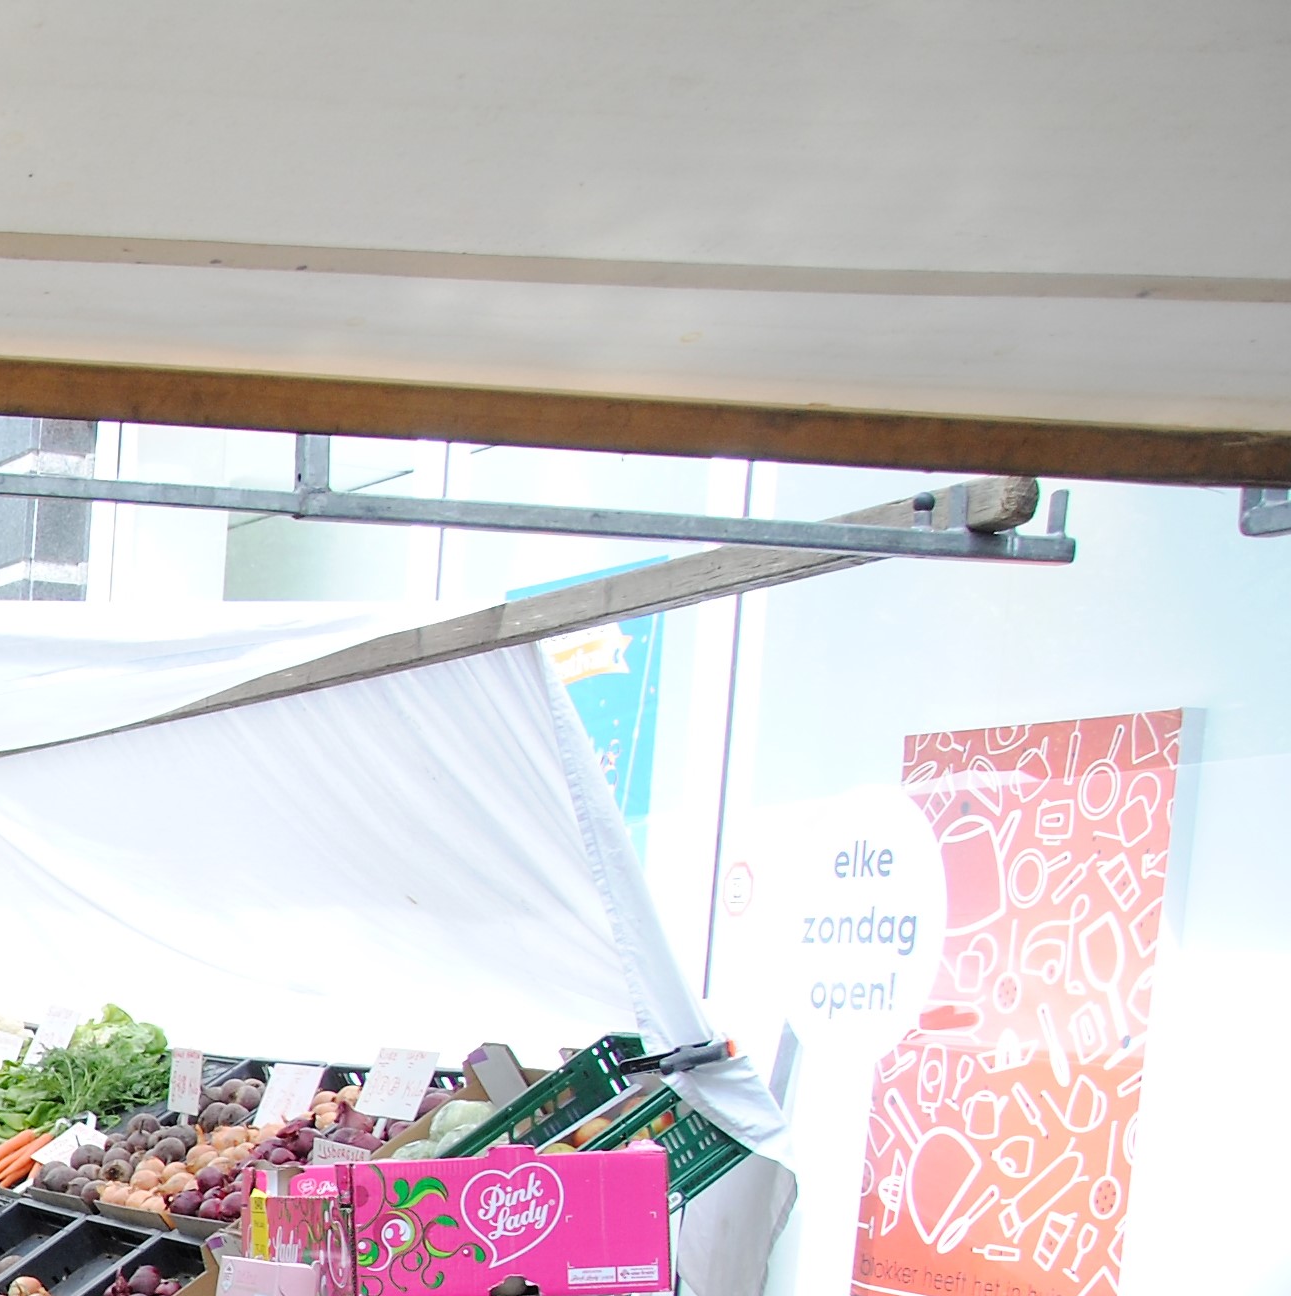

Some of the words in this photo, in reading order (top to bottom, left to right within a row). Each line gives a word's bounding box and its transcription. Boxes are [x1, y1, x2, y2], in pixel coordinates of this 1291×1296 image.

[834, 840, 893, 879] elke
[801, 906, 917, 956] zondag
[810, 972, 896, 1019] open!
[478, 1170, 544, 1219] Pink
[486, 1203, 549, 1242] Lady
[859, 1253, 917, 1283] blokker
[923, 1268, 967, 1292] heeft
